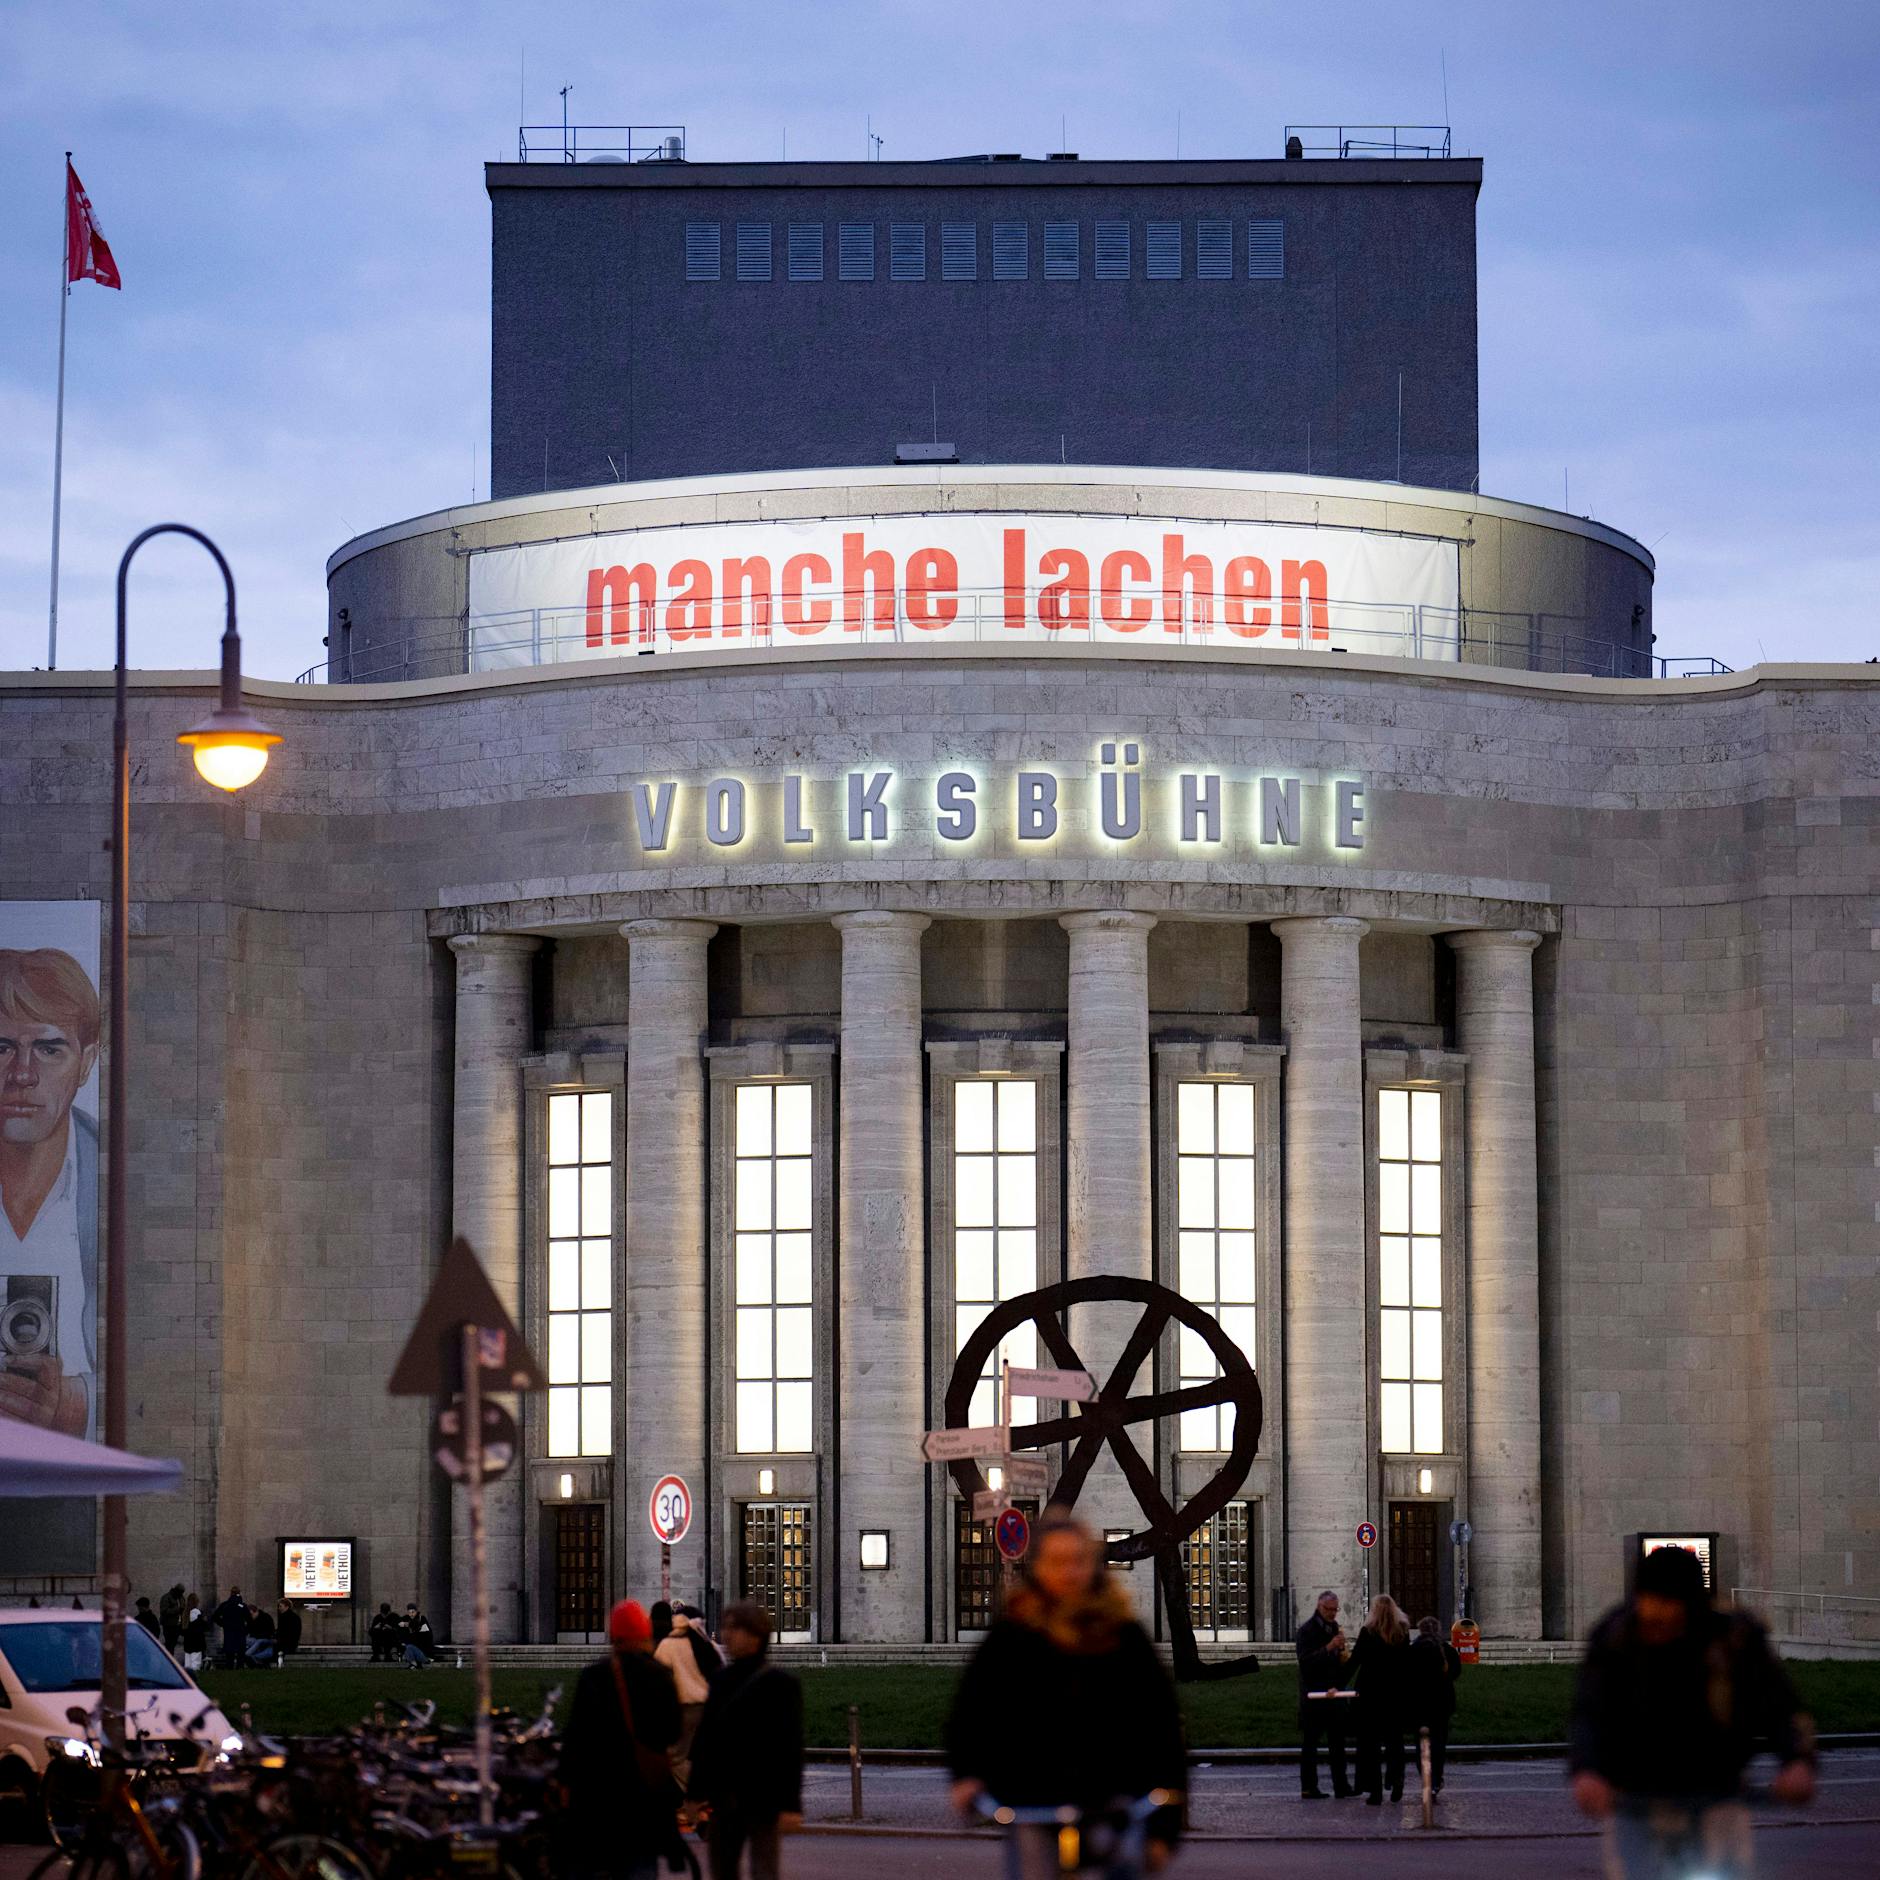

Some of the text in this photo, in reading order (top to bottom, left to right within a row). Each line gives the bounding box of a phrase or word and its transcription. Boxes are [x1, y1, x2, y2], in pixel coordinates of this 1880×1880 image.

[586, 529, 1329, 647] manche lachen
[632, 743, 1364, 850] VOLKSBÜHNE
[660, 1495, 681, 1522] 30
[305, 1547, 316, 1590] METHOD
[338, 1546, 349, 1590] METHOD
